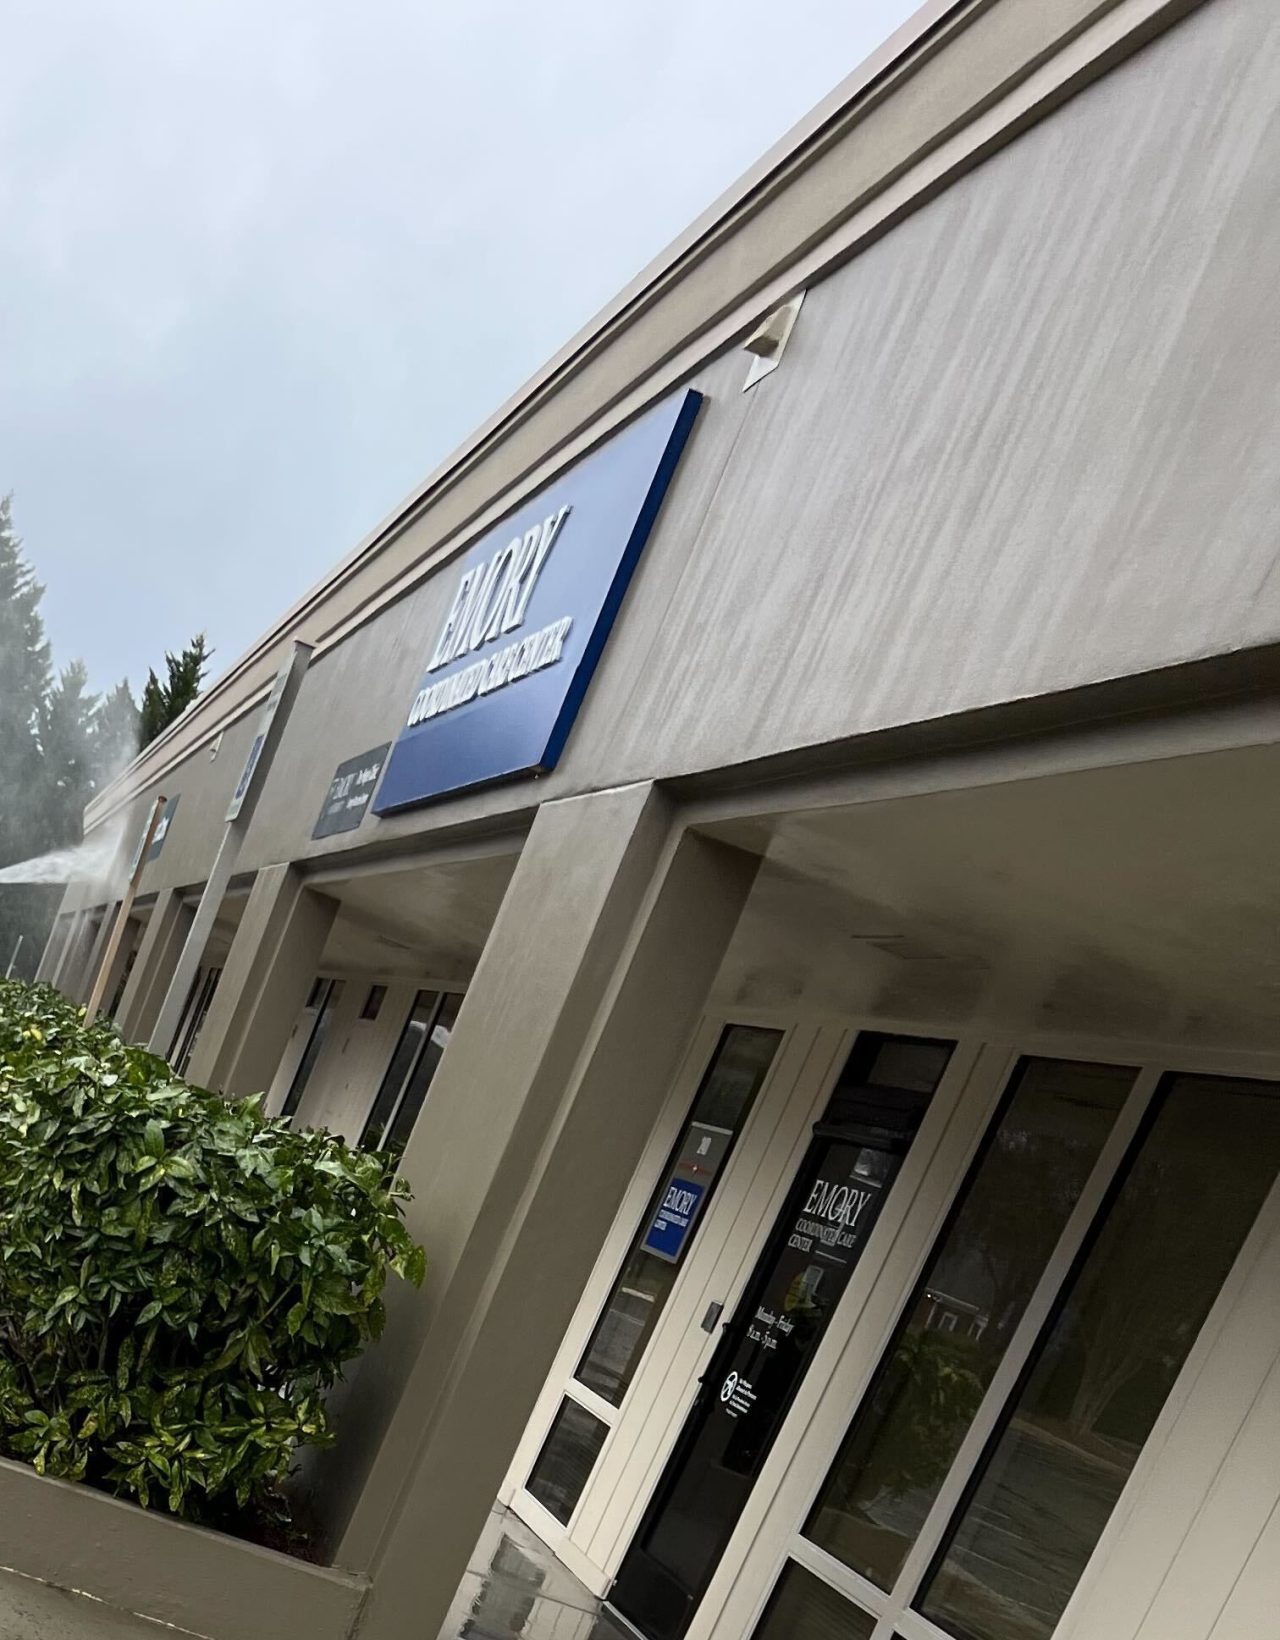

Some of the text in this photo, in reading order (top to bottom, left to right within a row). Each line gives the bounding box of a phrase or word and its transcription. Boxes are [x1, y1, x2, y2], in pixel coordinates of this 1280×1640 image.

[426, 504, 570, 672] EMORY
[663, 1186, 697, 1215] EMORY
[803, 1179, 872, 1227] EMORY
